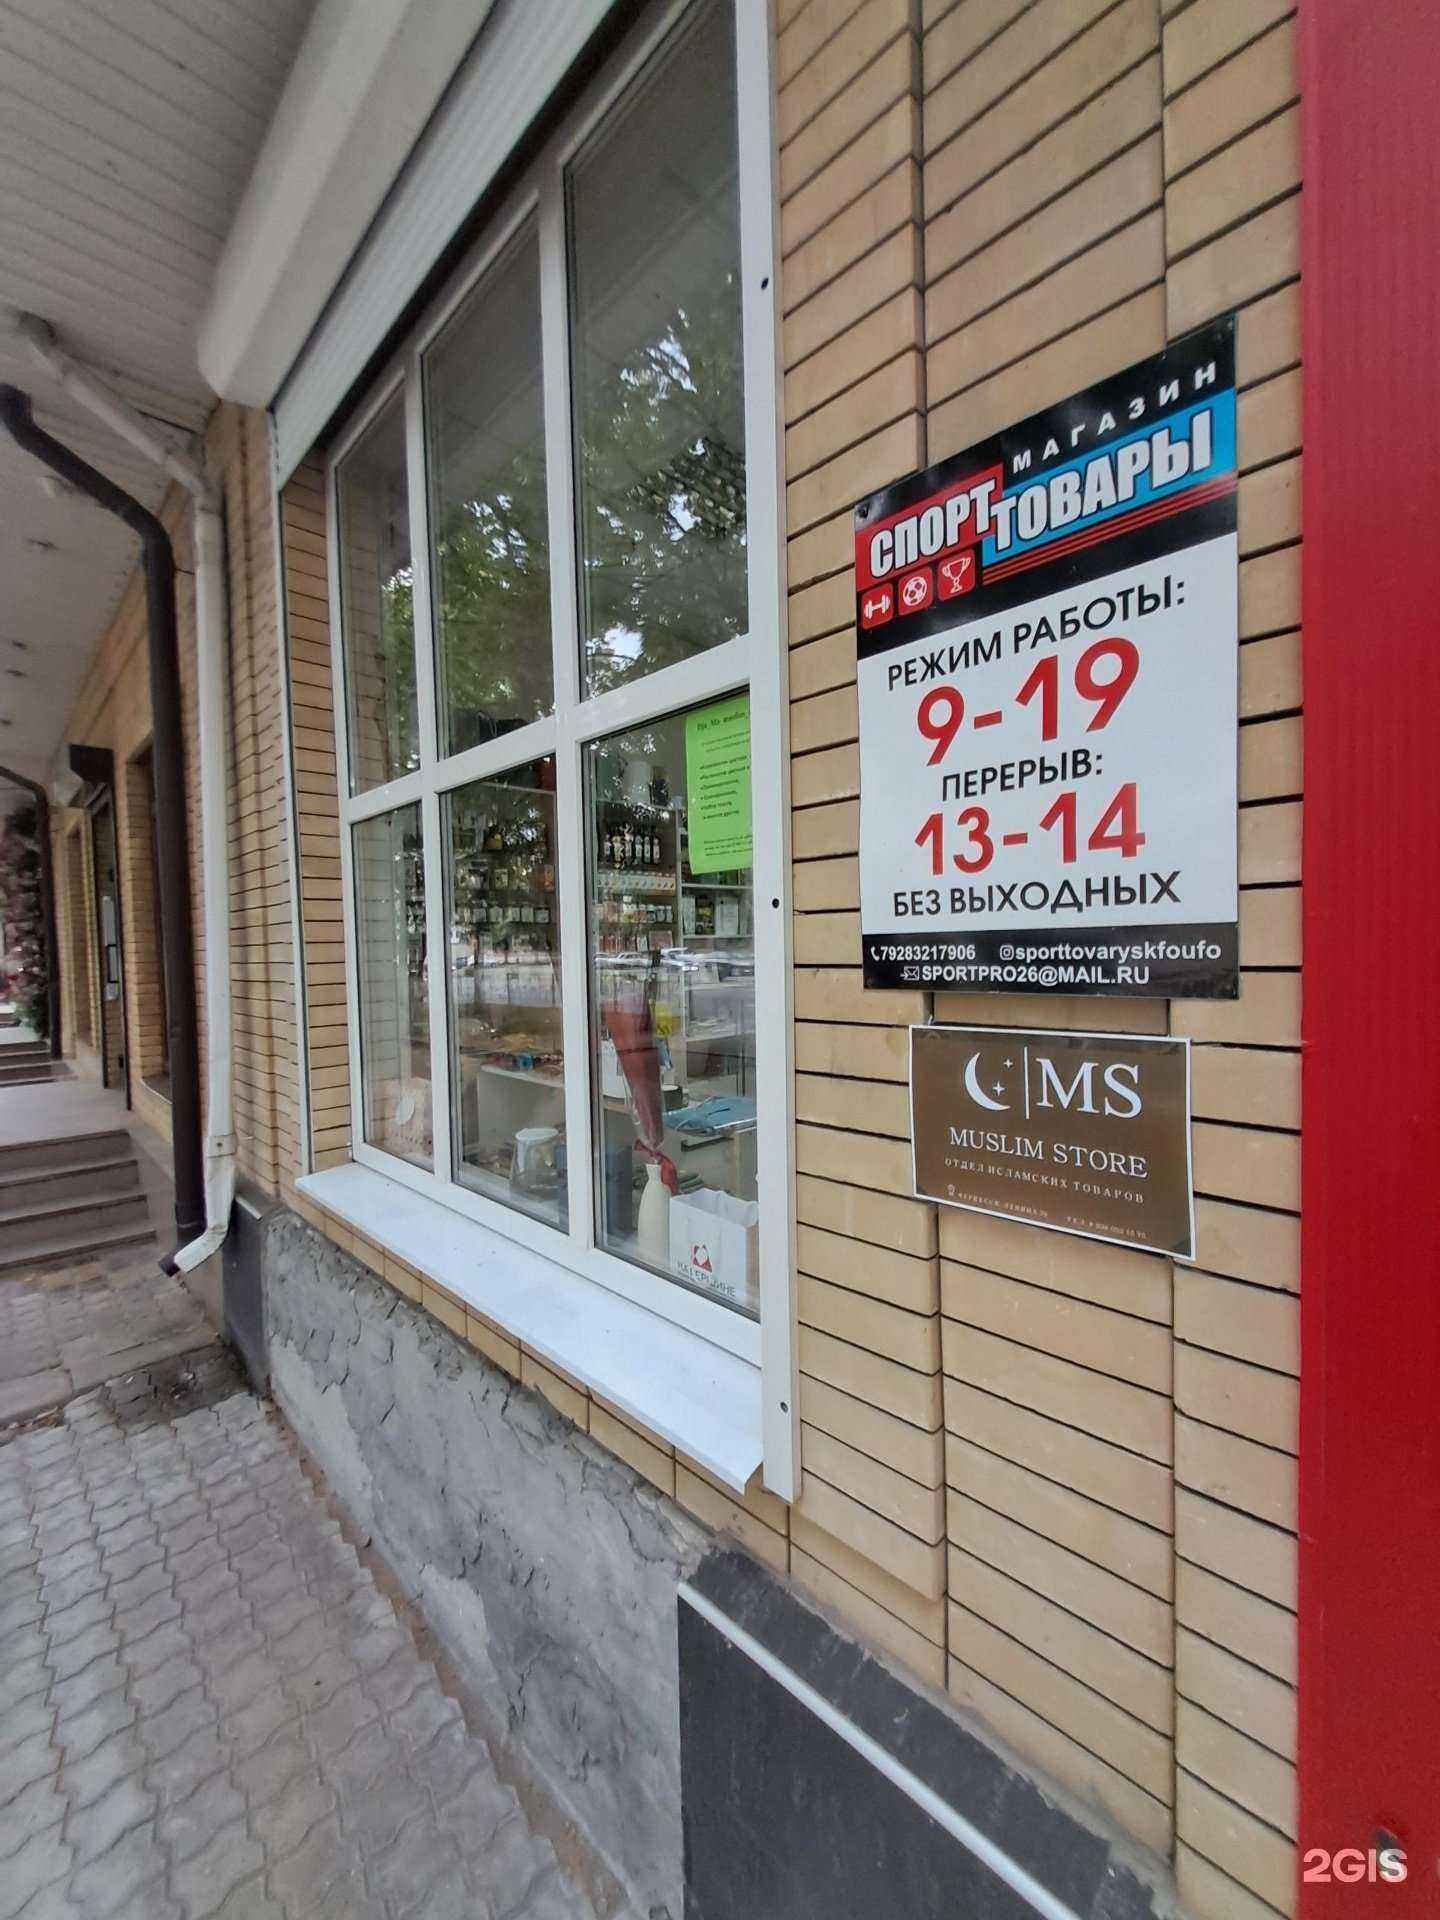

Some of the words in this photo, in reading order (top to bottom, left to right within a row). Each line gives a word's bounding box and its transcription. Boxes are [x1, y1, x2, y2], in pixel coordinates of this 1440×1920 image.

[1013, 361, 1216, 474] МАГАЗИН
[869, 478, 997, 579] СПОРТ
[989, 408, 1213, 553] ТОВАРЫ
[888, 631, 1002, 691] РЕЖИМ
[1013, 575, 1185, 654] РАБОТЫ:
[916, 637, 1140, 767] 9-19
[942, 748, 1103, 801] ПЕРЕРЫВ:
[914, 782, 1146, 876] 13-14
[893, 888, 941, 917] БЕЗ
[950, 870, 1181, 914] ВЫХОДНЫХ
[880, 945, 976, 961] 79283217906
[922, 965, 1150, 987] SPORTPRO26@MAIL.RU
[1036, 1057, 1142, 1119] MS
[949, 1126, 1044, 1160] MUSLIM
[1053, 1143, 1148, 1178] STORE
[945, 1158, 984, 1174] ОТДЕЛ
[988, 1165, 1068, 1189] ИСЛАМСКИХ
[1073, 1181, 1144, 1204] ТОВАРОВ
